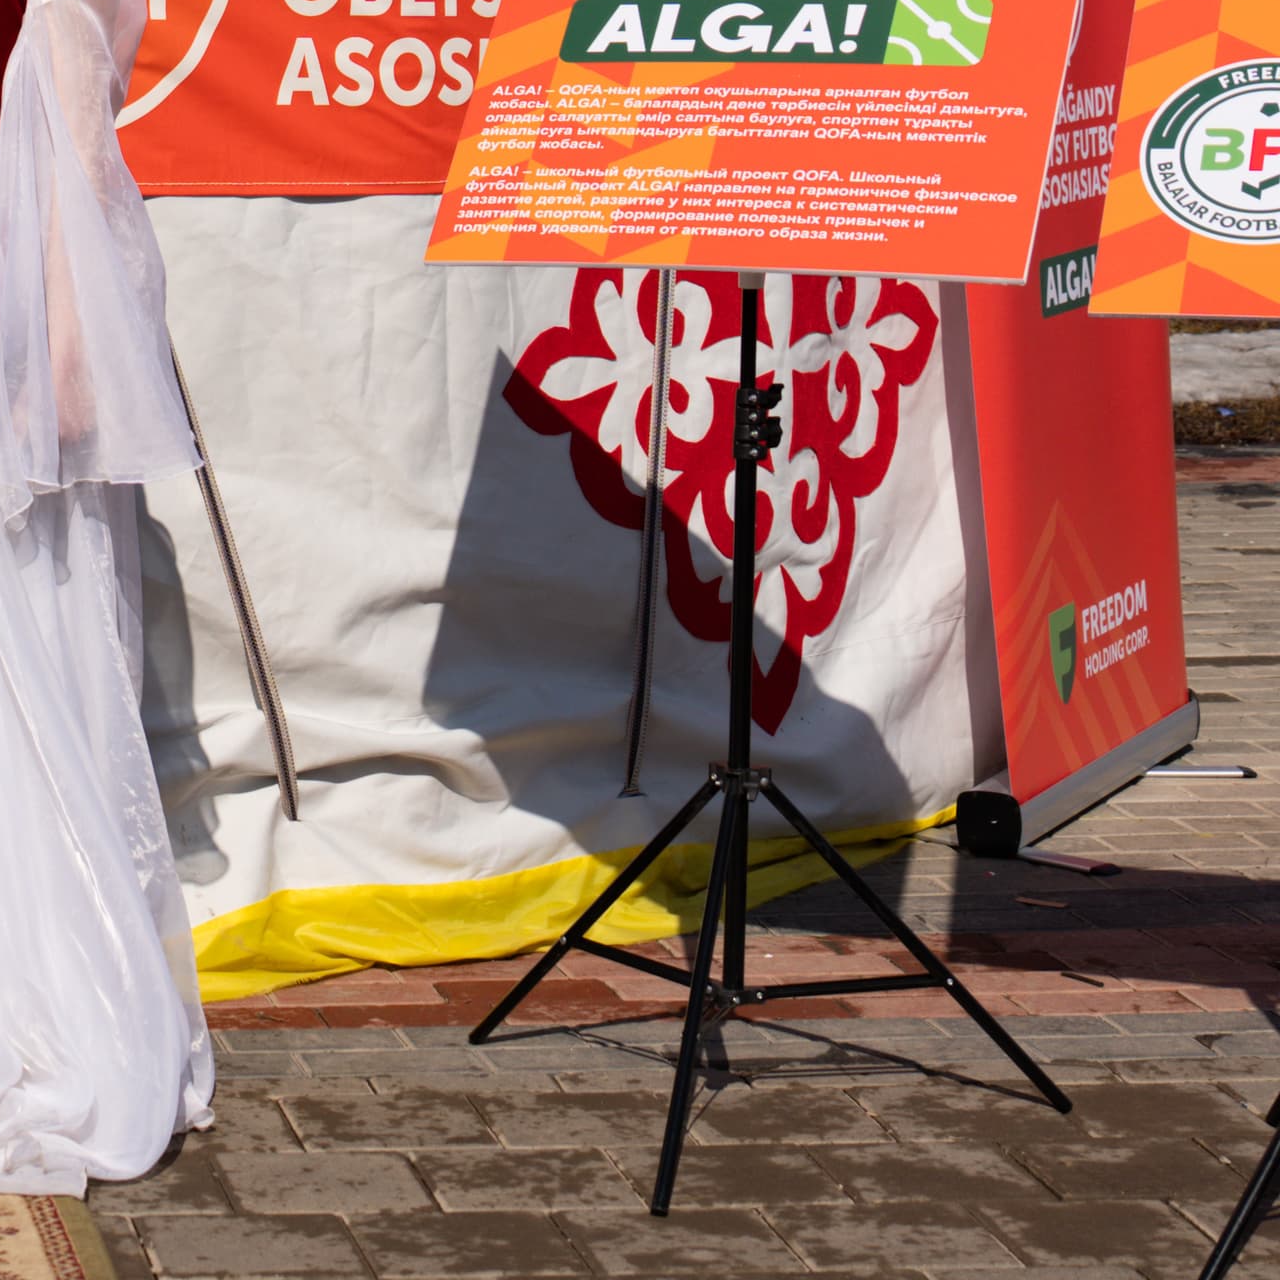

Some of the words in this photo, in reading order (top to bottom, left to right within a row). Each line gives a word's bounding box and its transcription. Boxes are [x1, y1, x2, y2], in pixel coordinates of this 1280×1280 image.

[586, 2, 867, 55] ALGA!
[492, 85, 542, 95] ALGA!
[644, 86, 699, 94] мектеп
[905, 88, 968, 101] футбол
[556, 97, 606, 107] ALGA!
[726, 100, 766, 110] дене
[485, 113, 544, 123] оларды
[548, 113, 631, 123] салауатты
[675, 113, 744, 122] салтына
[821, 116, 899, 127] спортпен
[477, 138, 535, 151] футбол
[469, 165, 519, 176] ALGA!
[535, 166, 618, 176] школьный
[622, 166, 727, 179] футбольный
[731, 170, 788, 181] проект
[849, 171, 941, 184] Школьный
[465, 179, 566, 192] футбольный
[570, 181, 624, 192] проект
[627, 181, 680, 191] ALGA!
[683, 183, 771, 194] направлен
[775, 185, 795, 194] на
[799, 186, 909, 198] гармоничное
[914, 187, 1017, 202] физическое
[1157, 161, 1209, 220] BALALAR
[460, 195, 532, 206] развитие
[590, 196, 664, 206] развитие
[668, 197, 678, 208] у
[682, 197, 711, 206] них
[716, 198, 791, 209] интереса
[796, 200, 805, 208] к
[809, 200, 957, 214] систематическим
[457, 209, 530, 218] занятиям
[609, 209, 734, 222] формирование
[738, 213, 820, 224] полезных
[824, 216, 909, 227] привычек
[913, 219, 924, 227] и
[453, 223, 536, 233] получения
[540, 224, 655, 234] удовольствия
[659, 225, 678, 234] от
[681, 226, 764, 237] активного
[769, 227, 827, 240] образа
[1081, 578, 1148, 644] FREEDOM
[1085, 637, 1125, 679] HOLDING
[1125, 625, 1151, 657] CORP.
